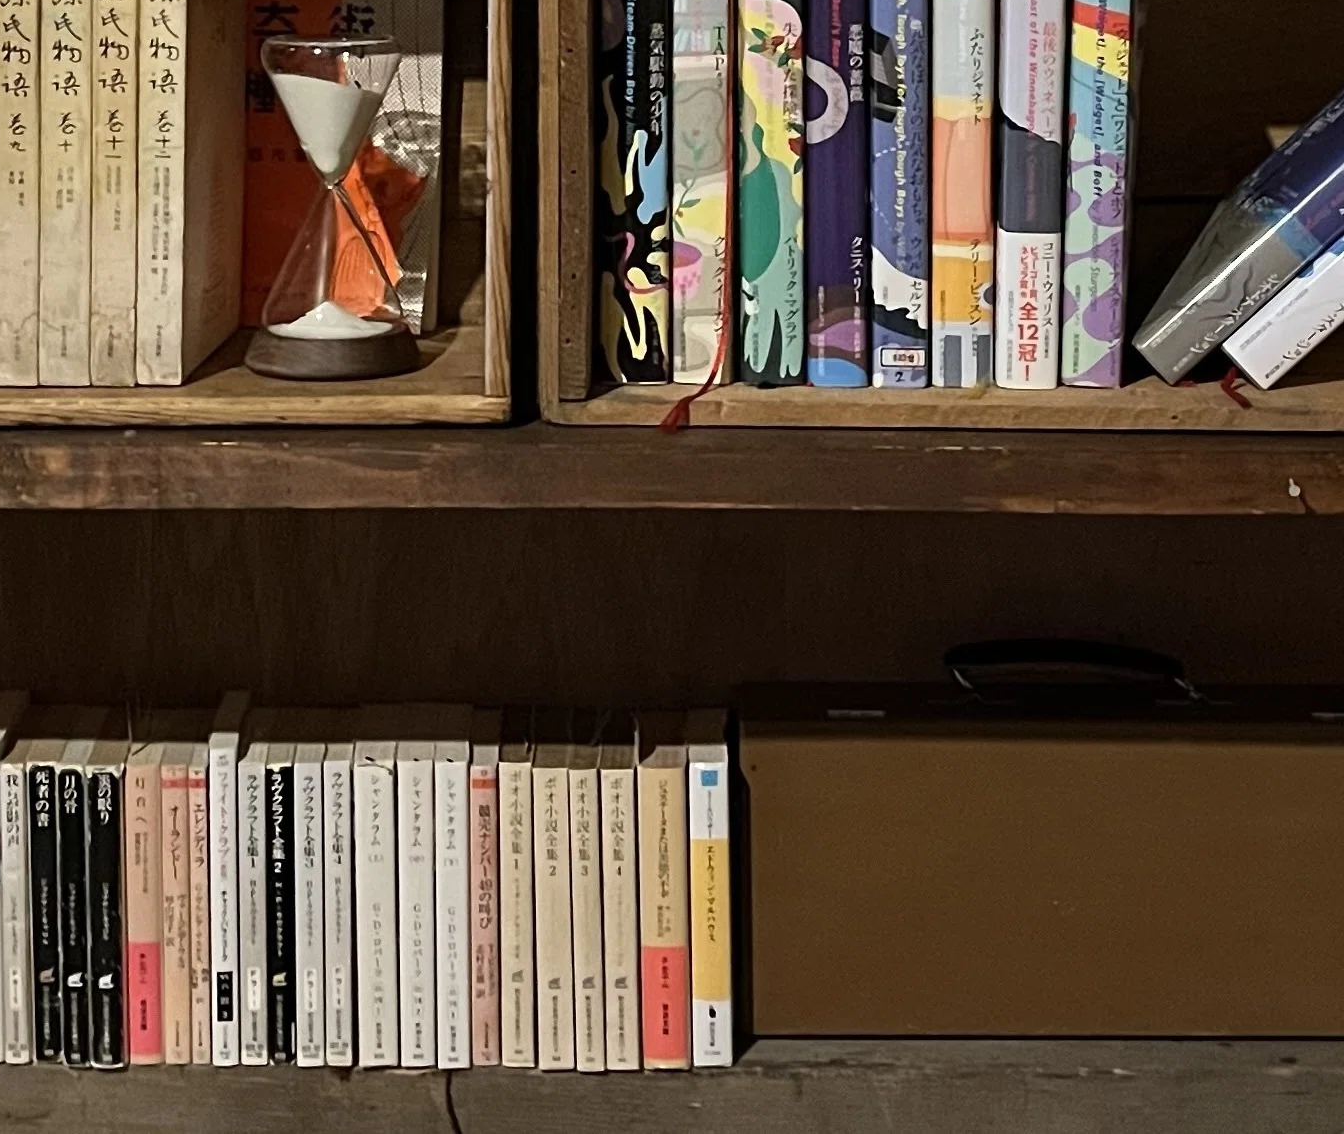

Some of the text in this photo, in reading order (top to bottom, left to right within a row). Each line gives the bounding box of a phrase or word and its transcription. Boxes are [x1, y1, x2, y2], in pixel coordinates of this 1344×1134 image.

[1029, 38, 1039, 58] the
[1030, 22, 1040, 35] of
[624, 80, 636, 104] Boy
[649, 22, 665, 136] 蒸気駆動の少年
[1096, 56, 1107, 75] the
[7, 112, 27, 153] 巻九
[57, 112, 78, 154] 巻十
[103, 110, 122, 160] 巻十一
[152, 111, 173, 160] 巻十二
[848, 23, 865, 303] 悪魔の薔薇 タニス・リー
[1093, 144, 1103, 167] and
[893, 189, 906, 218] Boys
[968, 29, 985, 326] ふたりジャネット テリー・ビッスン
[1092, 170, 1103, 197] Boff
[784, 236, 801, 344] パトリック・マグラア
[909, 236, 924, 314] ウィル・セルフ
[1042, 242, 1056, 328] コニー・ウィリス
[1189, 273, 1281, 356] シオドア・スタージョン
[35, 771, 50, 827] 死者の書
[63, 775, 77, 814] 月の骨
[246, 774, 259, 869] ラヴクラフト全集1
[271, 773, 286, 873] ラヴクラフト全集2
[302, 775, 314, 868] ラヴクラフト全集3
[369, 775, 382, 845] シャンタラム
[411, 776, 423, 847] シャンタラム
[446, 779, 457, 849] シャンタラム
[509, 772, 524, 870] ポオ小説全集1
[545, 777, 559, 877] ポオ小説全集2
[575, 777, 590, 877] ポオ小説全集3
[610, 777, 625, 877] ポオ小説全集4
[170, 805, 181, 880] オーランドー
[193, 803, 205, 868] エレンディラ
[478, 804, 494, 929] 競売ナンバー49の叫び
[707, 846, 717, 942] エドウィン・マルハウス
